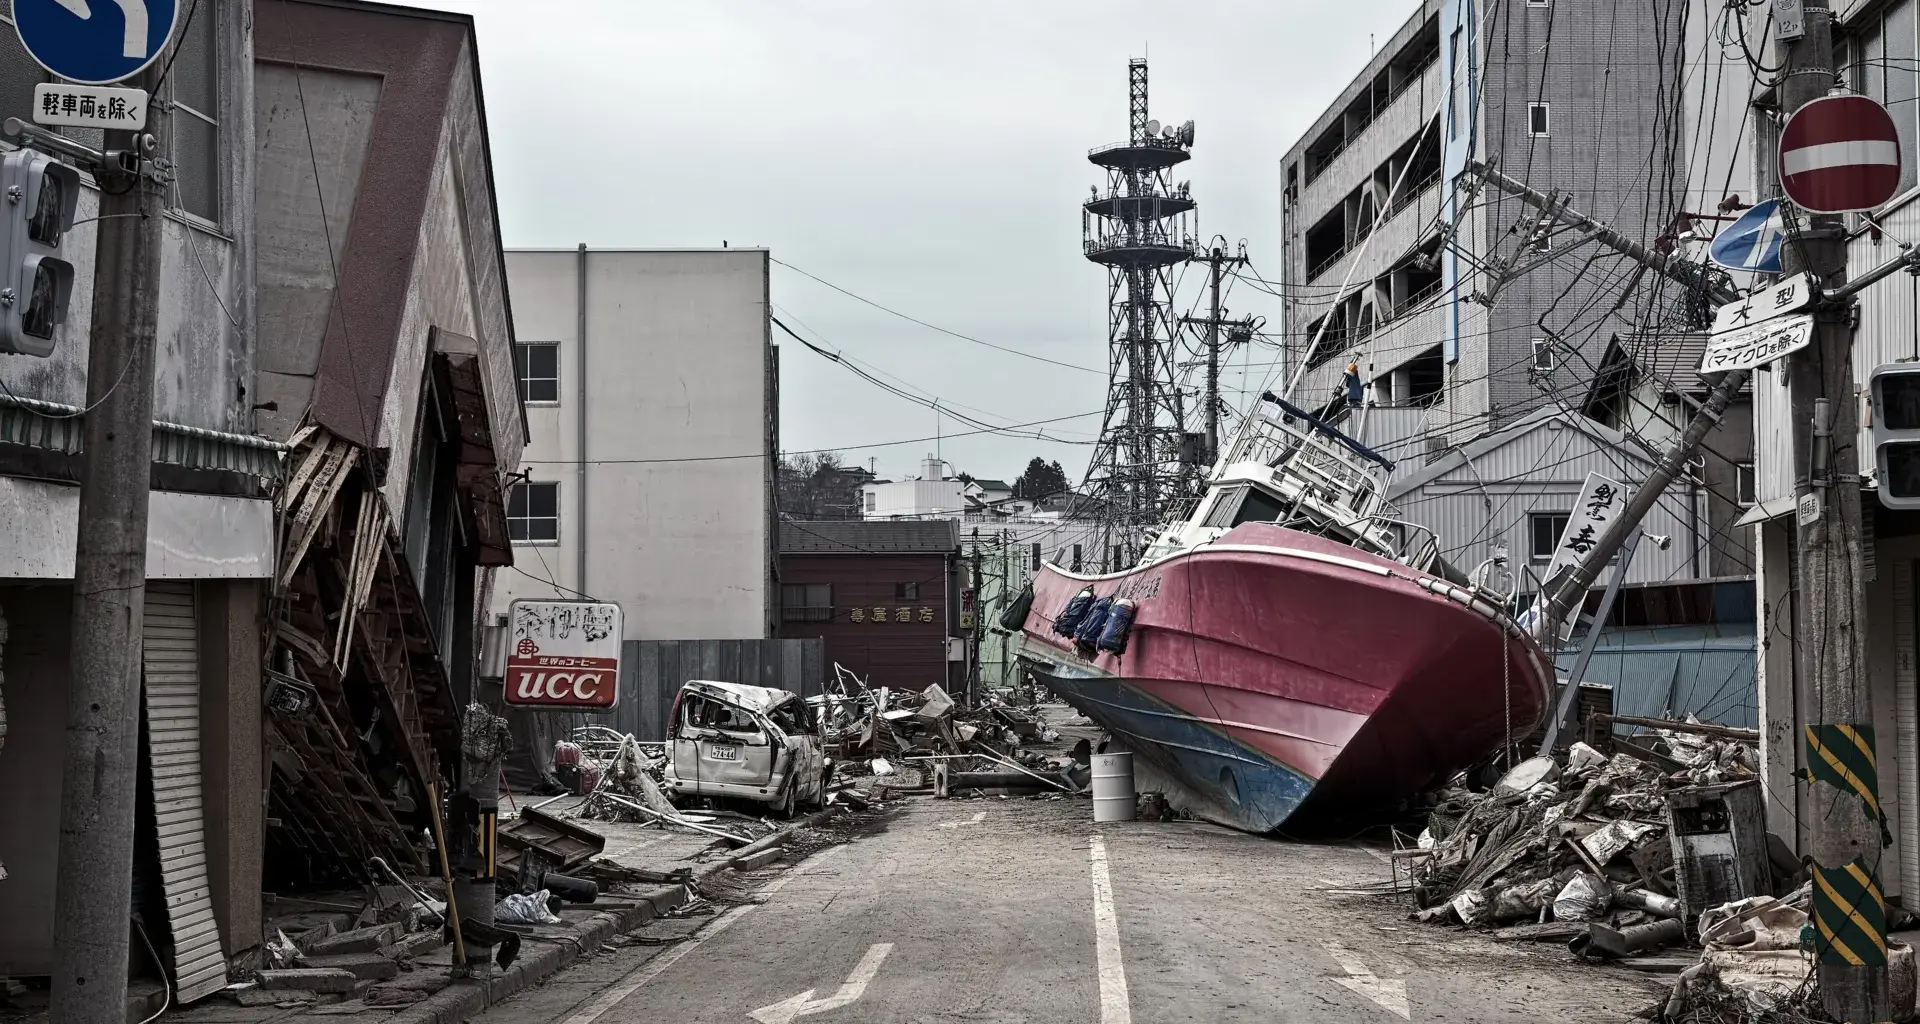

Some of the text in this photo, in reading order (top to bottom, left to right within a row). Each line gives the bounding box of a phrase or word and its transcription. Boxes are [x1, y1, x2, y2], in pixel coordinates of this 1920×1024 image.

[42, 92, 137, 120] 軽車両を除く
[1730, 284, 1795, 325] 大型
[1708, 328, 1805, 368] (マイクロを除く)
[539, 657, 597, 667] 世界のコーヒー
